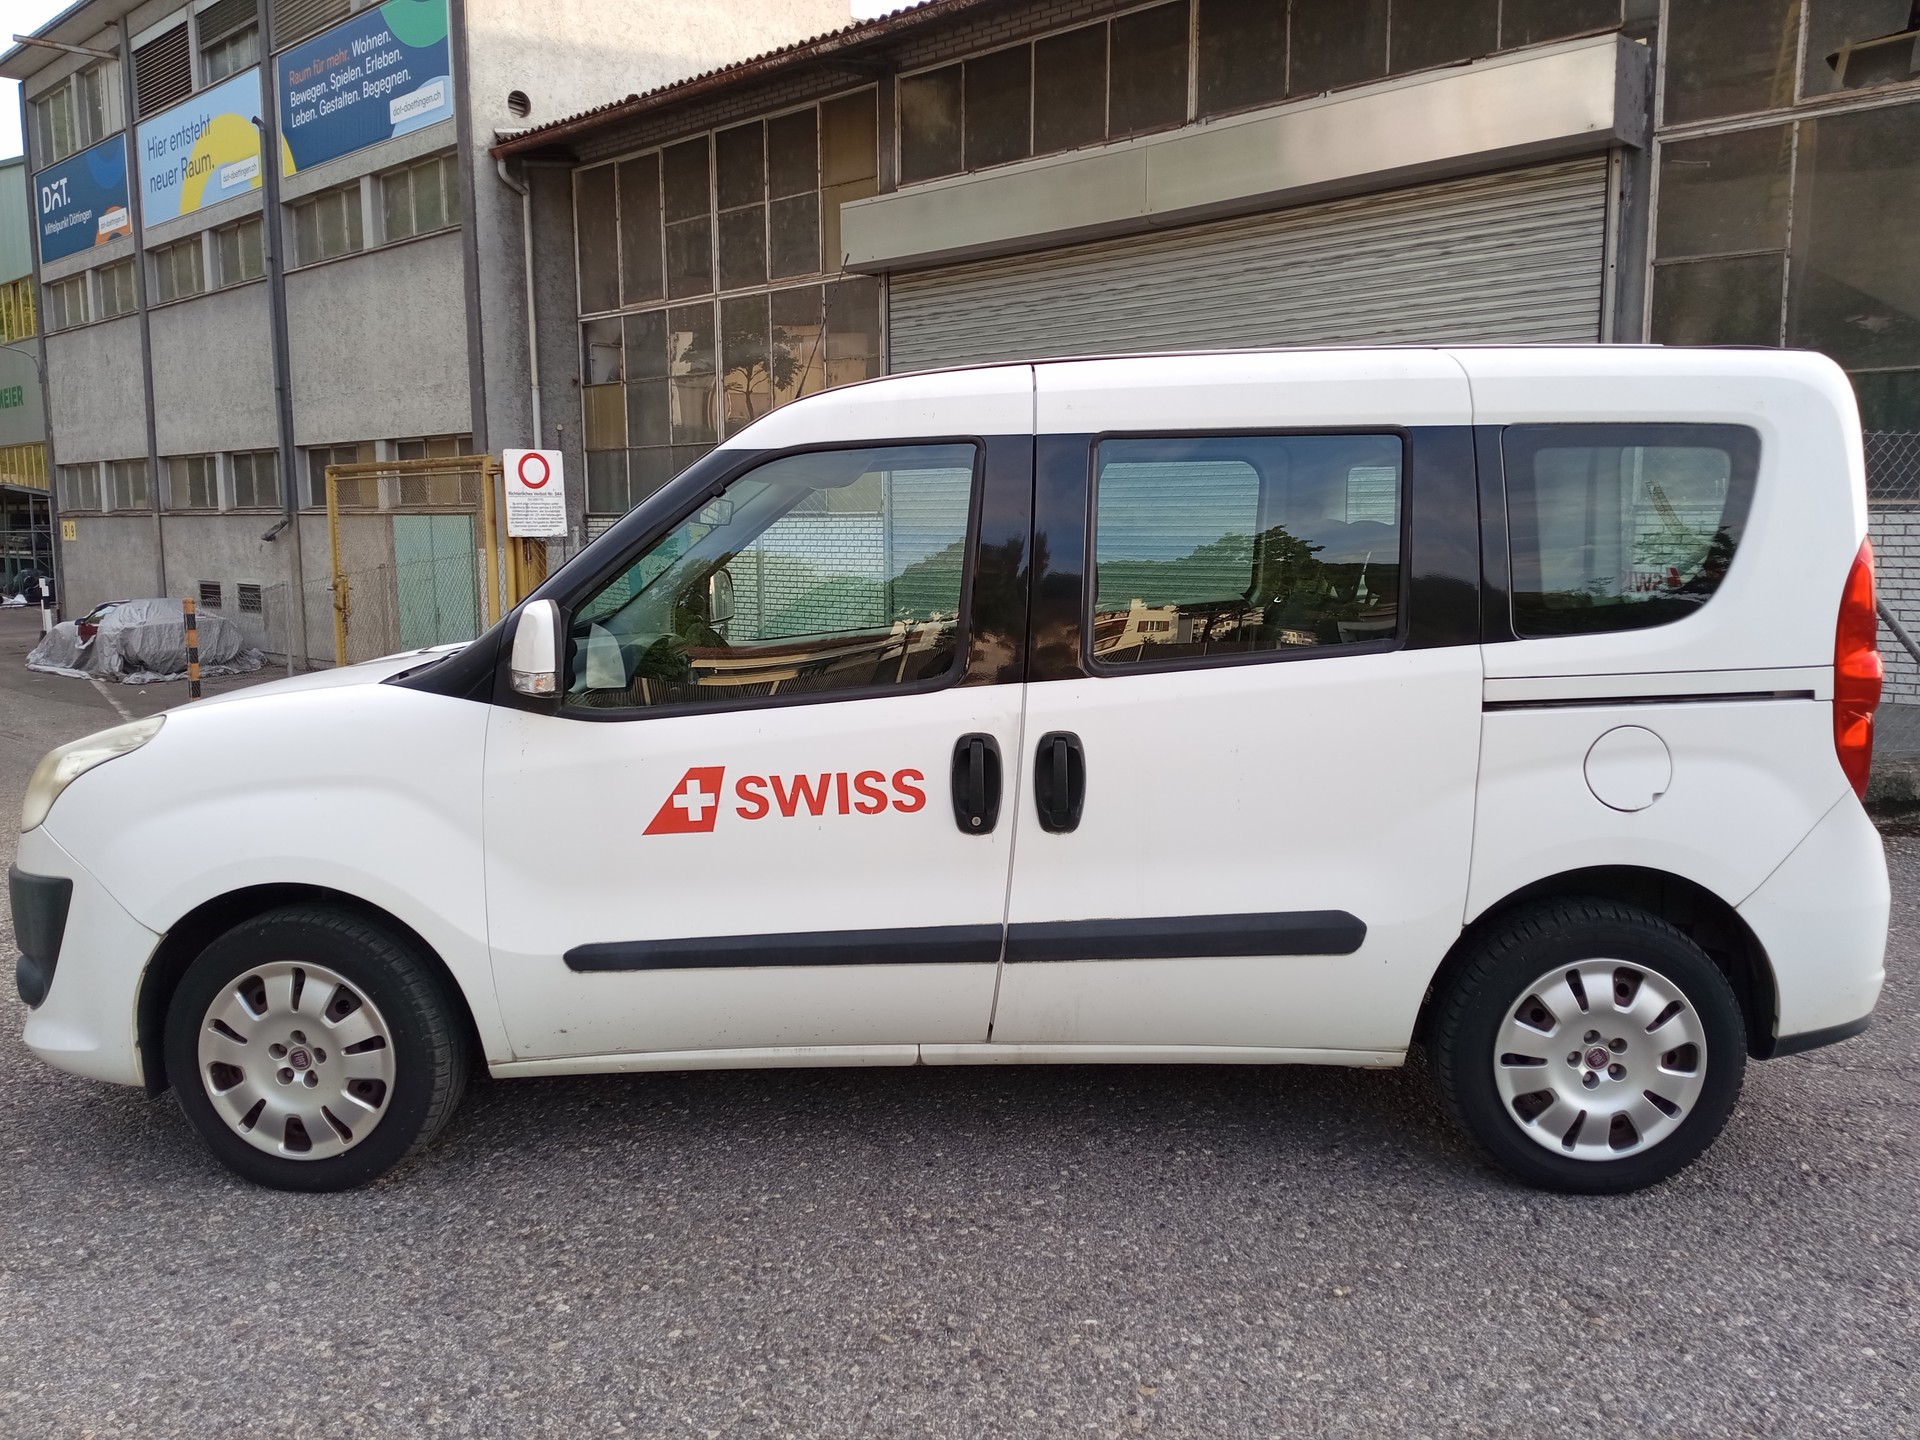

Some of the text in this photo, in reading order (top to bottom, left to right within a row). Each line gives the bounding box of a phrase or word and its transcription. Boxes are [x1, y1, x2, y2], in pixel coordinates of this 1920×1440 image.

[289, 30, 392, 87] Raum für mehr. Wohnen.
[290, 48, 403, 108] Bewegen. Spielen. Erleben.
[291, 68, 412, 128] Leben. Gestalten. Begegnen.
[392, 89, 442, 117] dot-doettingen.ch
[147, 114, 212, 161] Hier entsteht
[150, 153, 215, 194] neuer Raum.
[44, 209, 93, 235] Mittelpunkt Döttingen
[735, 768, 927, 820] SWISS
